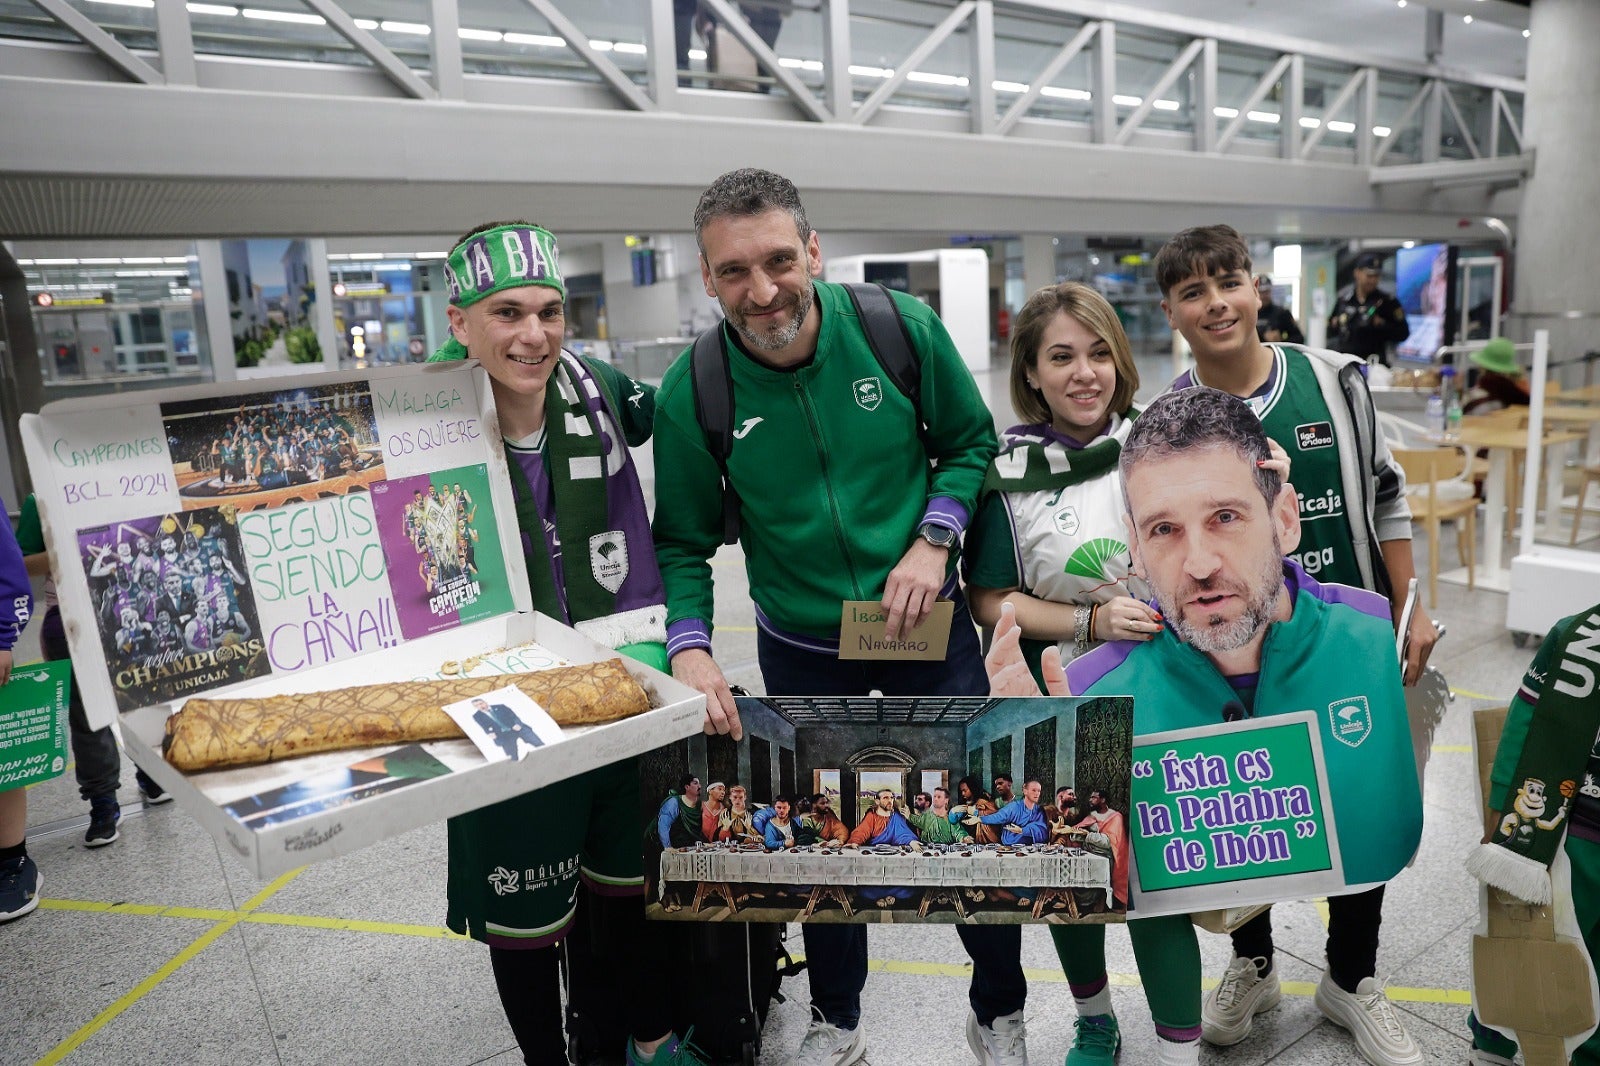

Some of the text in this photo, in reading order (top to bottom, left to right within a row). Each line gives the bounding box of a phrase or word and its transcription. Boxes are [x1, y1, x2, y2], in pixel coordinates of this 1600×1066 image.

[444, 242, 495, 296] AJA
[377, 388, 463, 418] MÁLAGA
[53, 437, 163, 468] CAMPEONES
[1300, 432, 1315, 441] liga
[63, 472, 168, 505] BCL 2024
[1299, 489, 1342, 513] icaja
[252, 543, 386, 602] SIENDO
[307, 592, 337, 618] LA
[269, 597, 398, 671] CAÑA!!
[859, 634, 928, 651] NAVARRO
[115, 638, 265, 689] CHAMPIONS
[175, 669, 230, 691] UNICAJA
[1162, 752, 1228, 792] Ésta
[1237, 749, 1272, 781] es
[1137, 786, 1312, 836] la Palabra
[1165, 839, 1205, 873] de
[1211, 827, 1290, 867] Ibón
[525, 854, 580, 881] MÁLAGA
